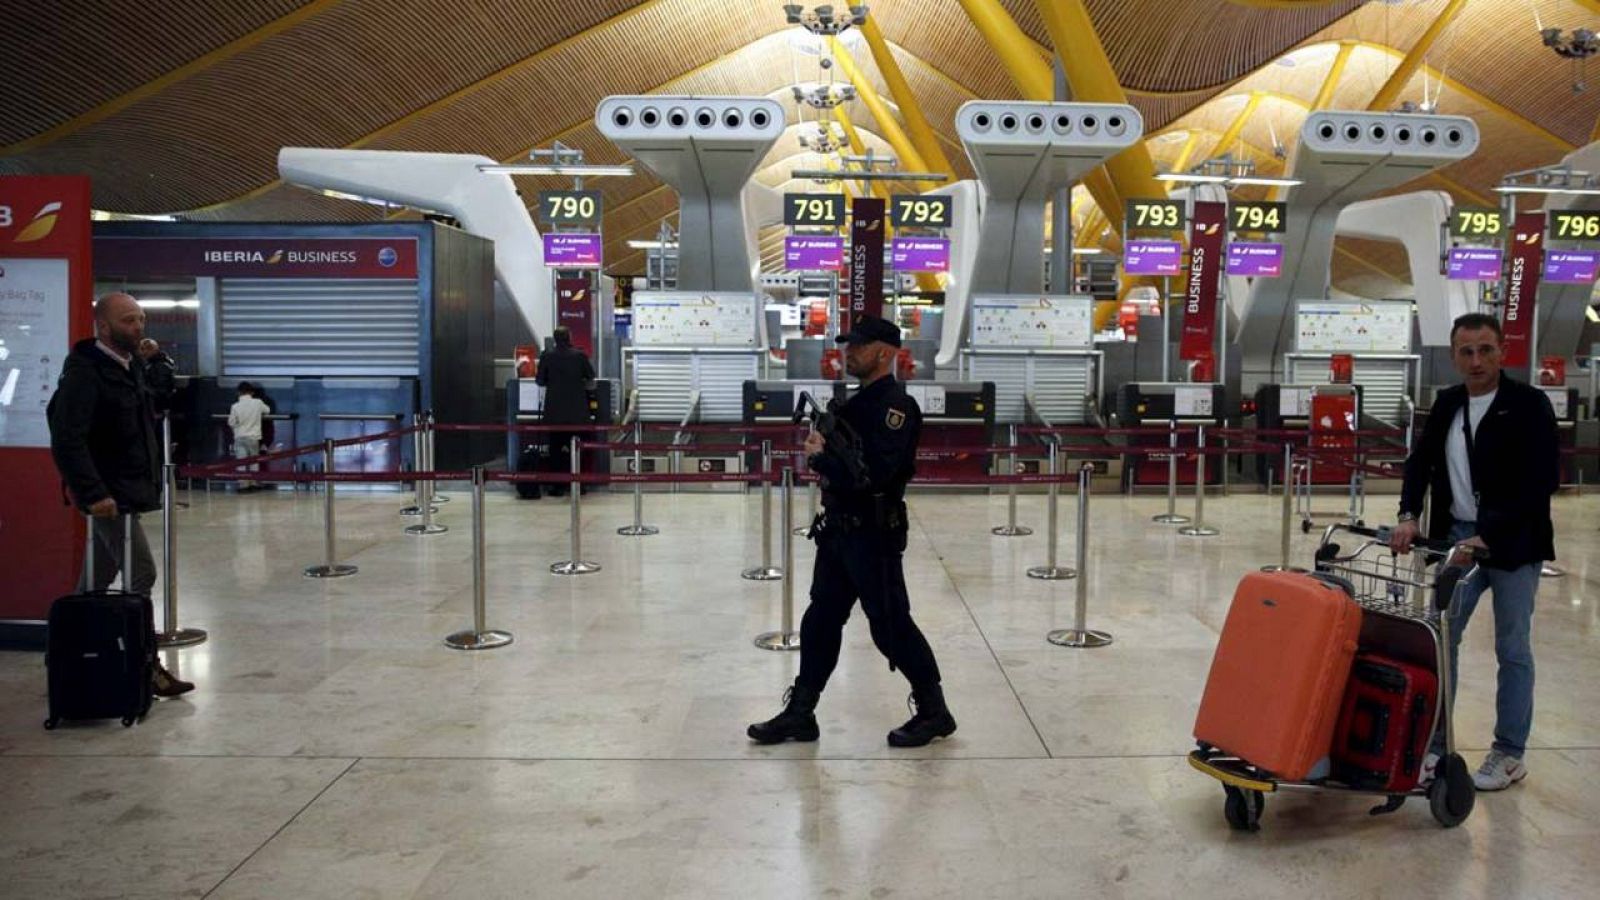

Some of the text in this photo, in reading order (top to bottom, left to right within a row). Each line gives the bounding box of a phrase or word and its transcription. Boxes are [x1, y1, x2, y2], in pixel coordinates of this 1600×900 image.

[548, 196, 595, 218] 790
[794, 199, 836, 221] 791
[899, 201, 944, 222] 792
[1135, 204, 1179, 226] 793
[1235, 207, 1280, 229] 794
[1459, 212, 1500, 234] 795
[1557, 215, 1600, 236] 796
[204, 250, 357, 263] IBERIA BUSINESS
[854, 244, 866, 311] BUSINESS
[1188, 247, 1204, 313] BUSINESS
[1507, 257, 1525, 321] BUSINESS
